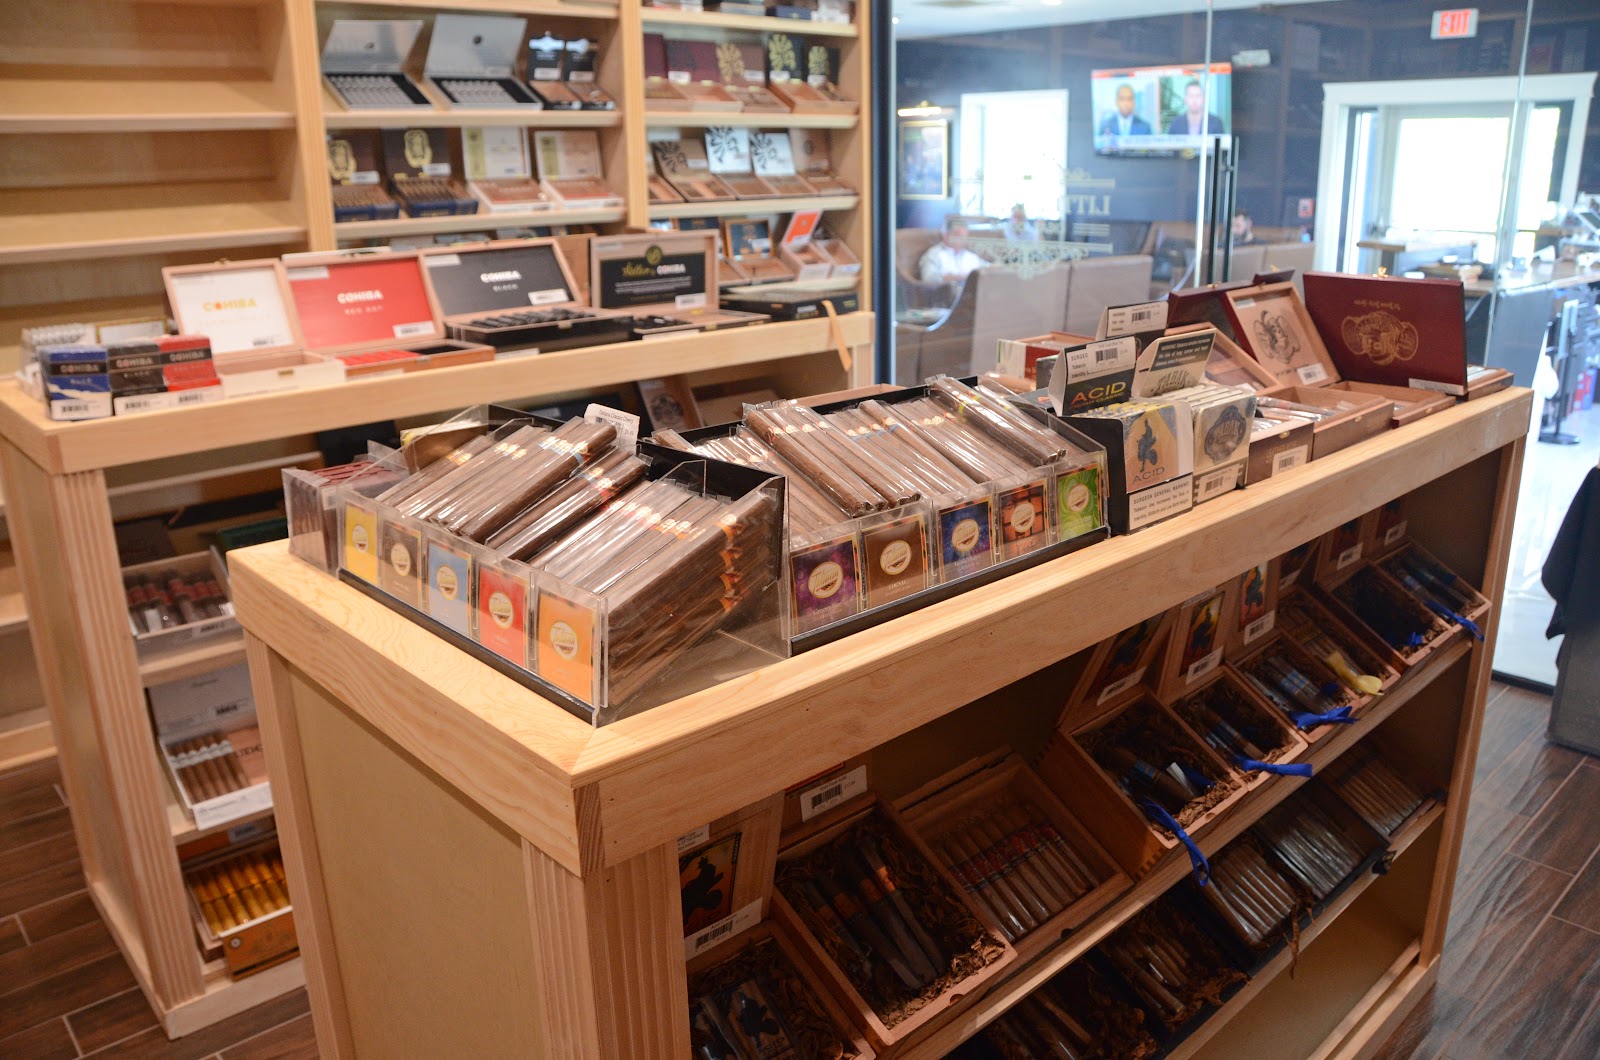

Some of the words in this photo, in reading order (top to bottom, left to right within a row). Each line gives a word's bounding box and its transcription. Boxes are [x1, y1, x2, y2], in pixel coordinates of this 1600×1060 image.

[1440, 10, 1472, 37] EXIT
[656, 263, 686, 275] COHIBA
[480, 270, 522, 283] COHIBA
[337, 289, 384, 304] COHIBA
[203, 298, 257, 313] COHIBA
[116, 357, 153, 368] COHIBA
[169, 351, 205, 362] COHIBA
[1071, 352, 1089, 361] SURGEO
[60, 364, 99, 374] COHIBA
[1071, 381, 1127, 405] ACID
[1132, 466, 1165, 485] ACID
[1133, 493, 1153, 504] SURGEON
[1154, 488, 1172, 498] GENERAL
